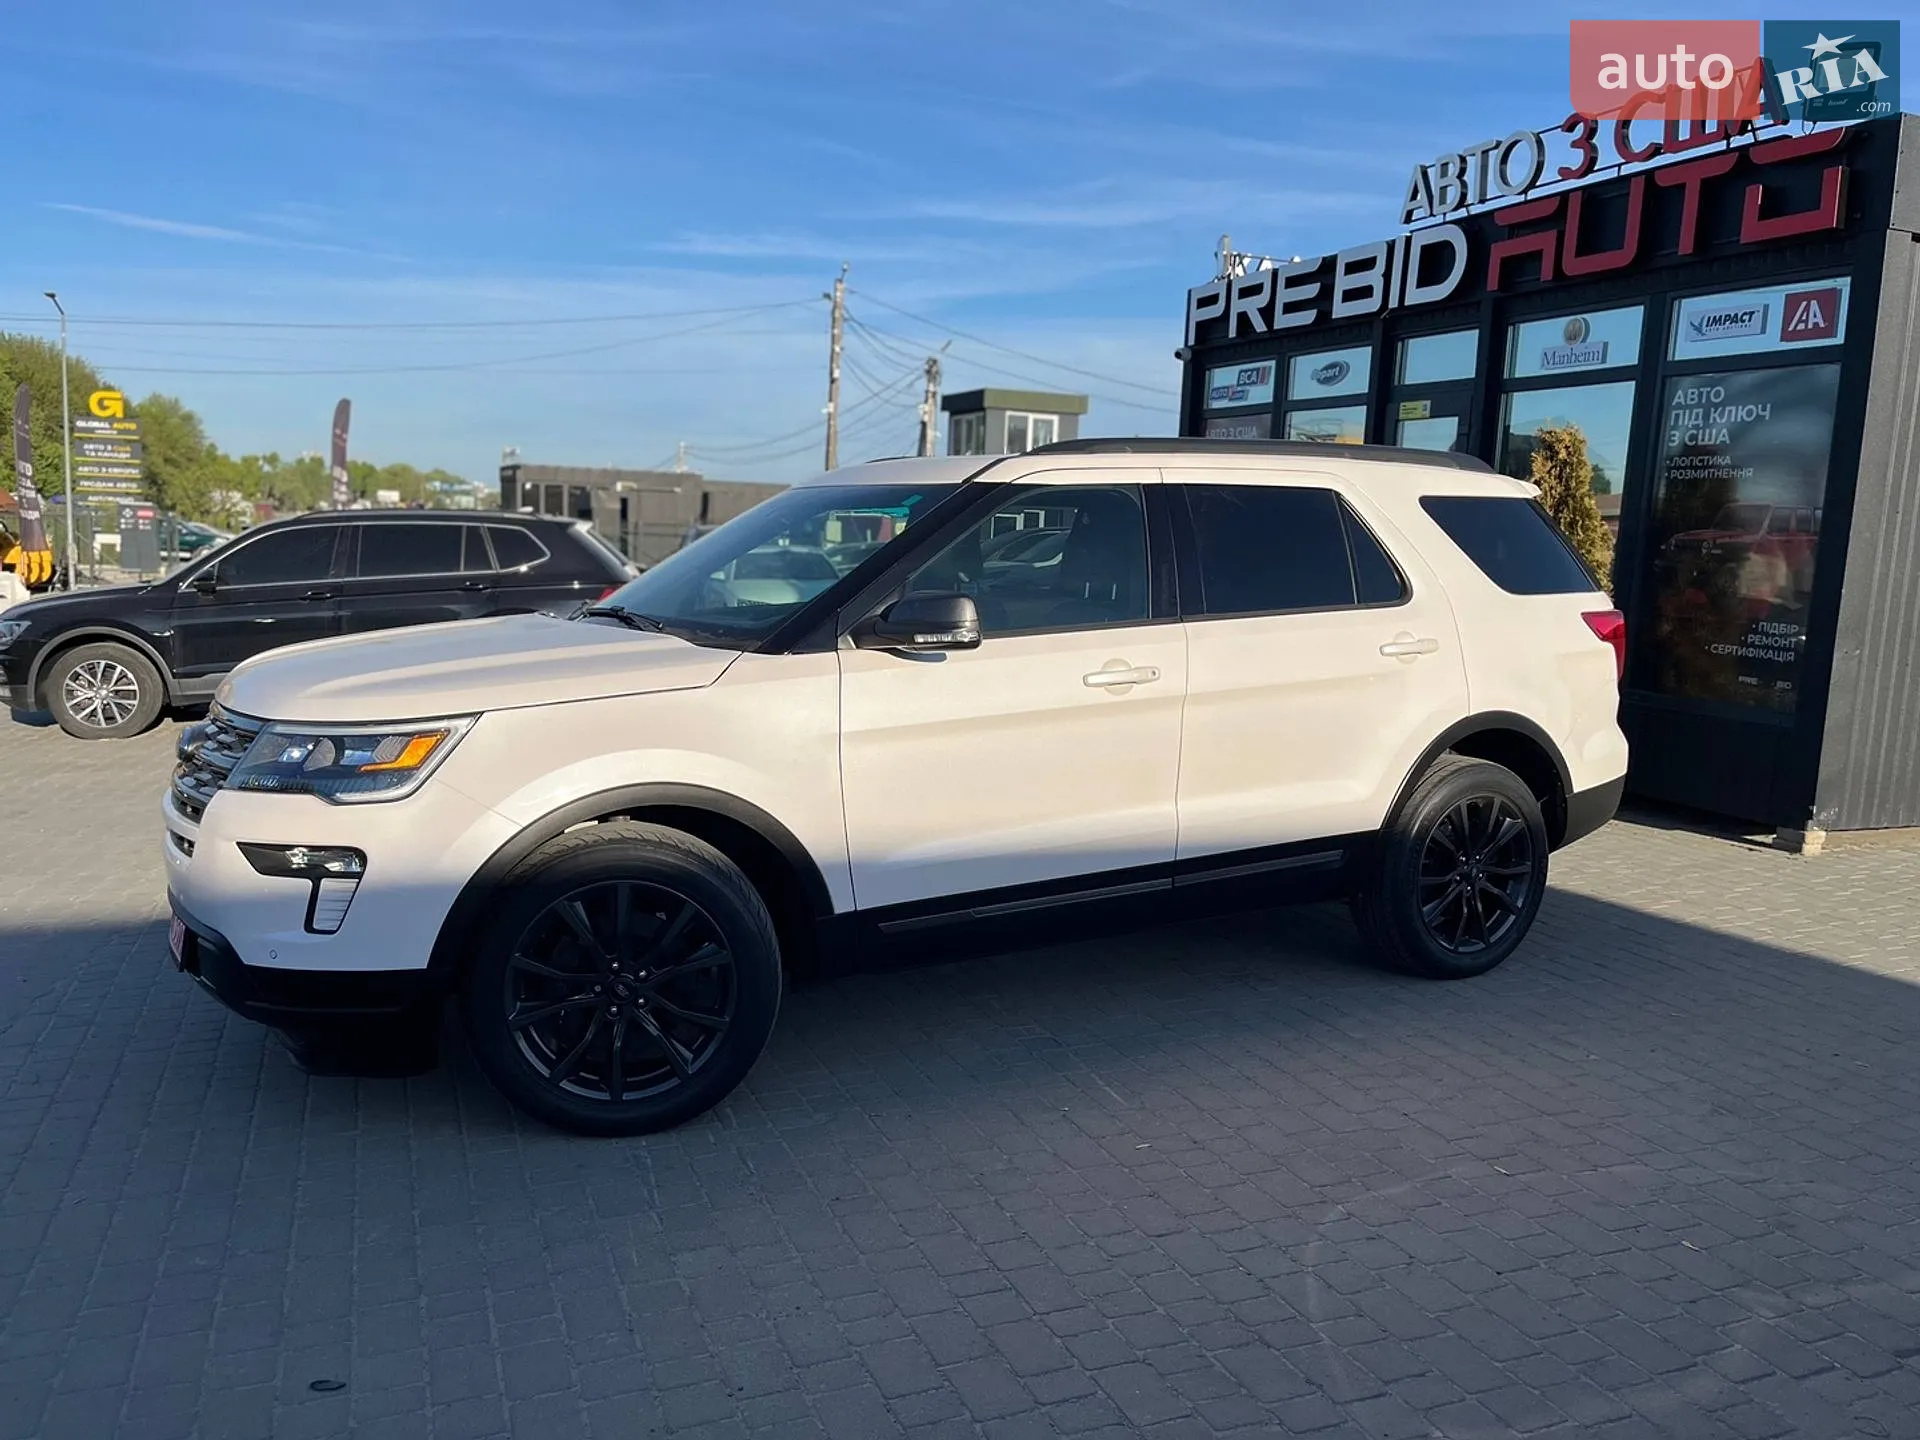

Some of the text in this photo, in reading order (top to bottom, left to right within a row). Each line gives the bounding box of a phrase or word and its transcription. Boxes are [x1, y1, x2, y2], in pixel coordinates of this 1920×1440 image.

[1401, 129, 1546, 225] АВТО
[1487, 126, 1850, 292] AUTO
[1705, 310, 1755, 328] IMPACT
[1542, 346, 1602, 367] Manheim
[1238, 370, 1258, 384] BCA
[1672, 386, 1725, 406] АВТО
[1670, 403, 1772, 428] ПІД КЛЮЧ
[75, 420, 137, 430] GLOBAL AUTO
[1684, 428, 1731, 446] США
[1671, 455, 1732, 467] ЛОГІСТИКА
[1670, 467, 1754, 480] РОЗМИТНЕННЯ
[1758, 621, 1799, 635] ПІДБІР
[1747, 634, 1798, 648] РЕМОНТ
[1710, 643, 1795, 663] СЕРТИФІКАЦІЯ
